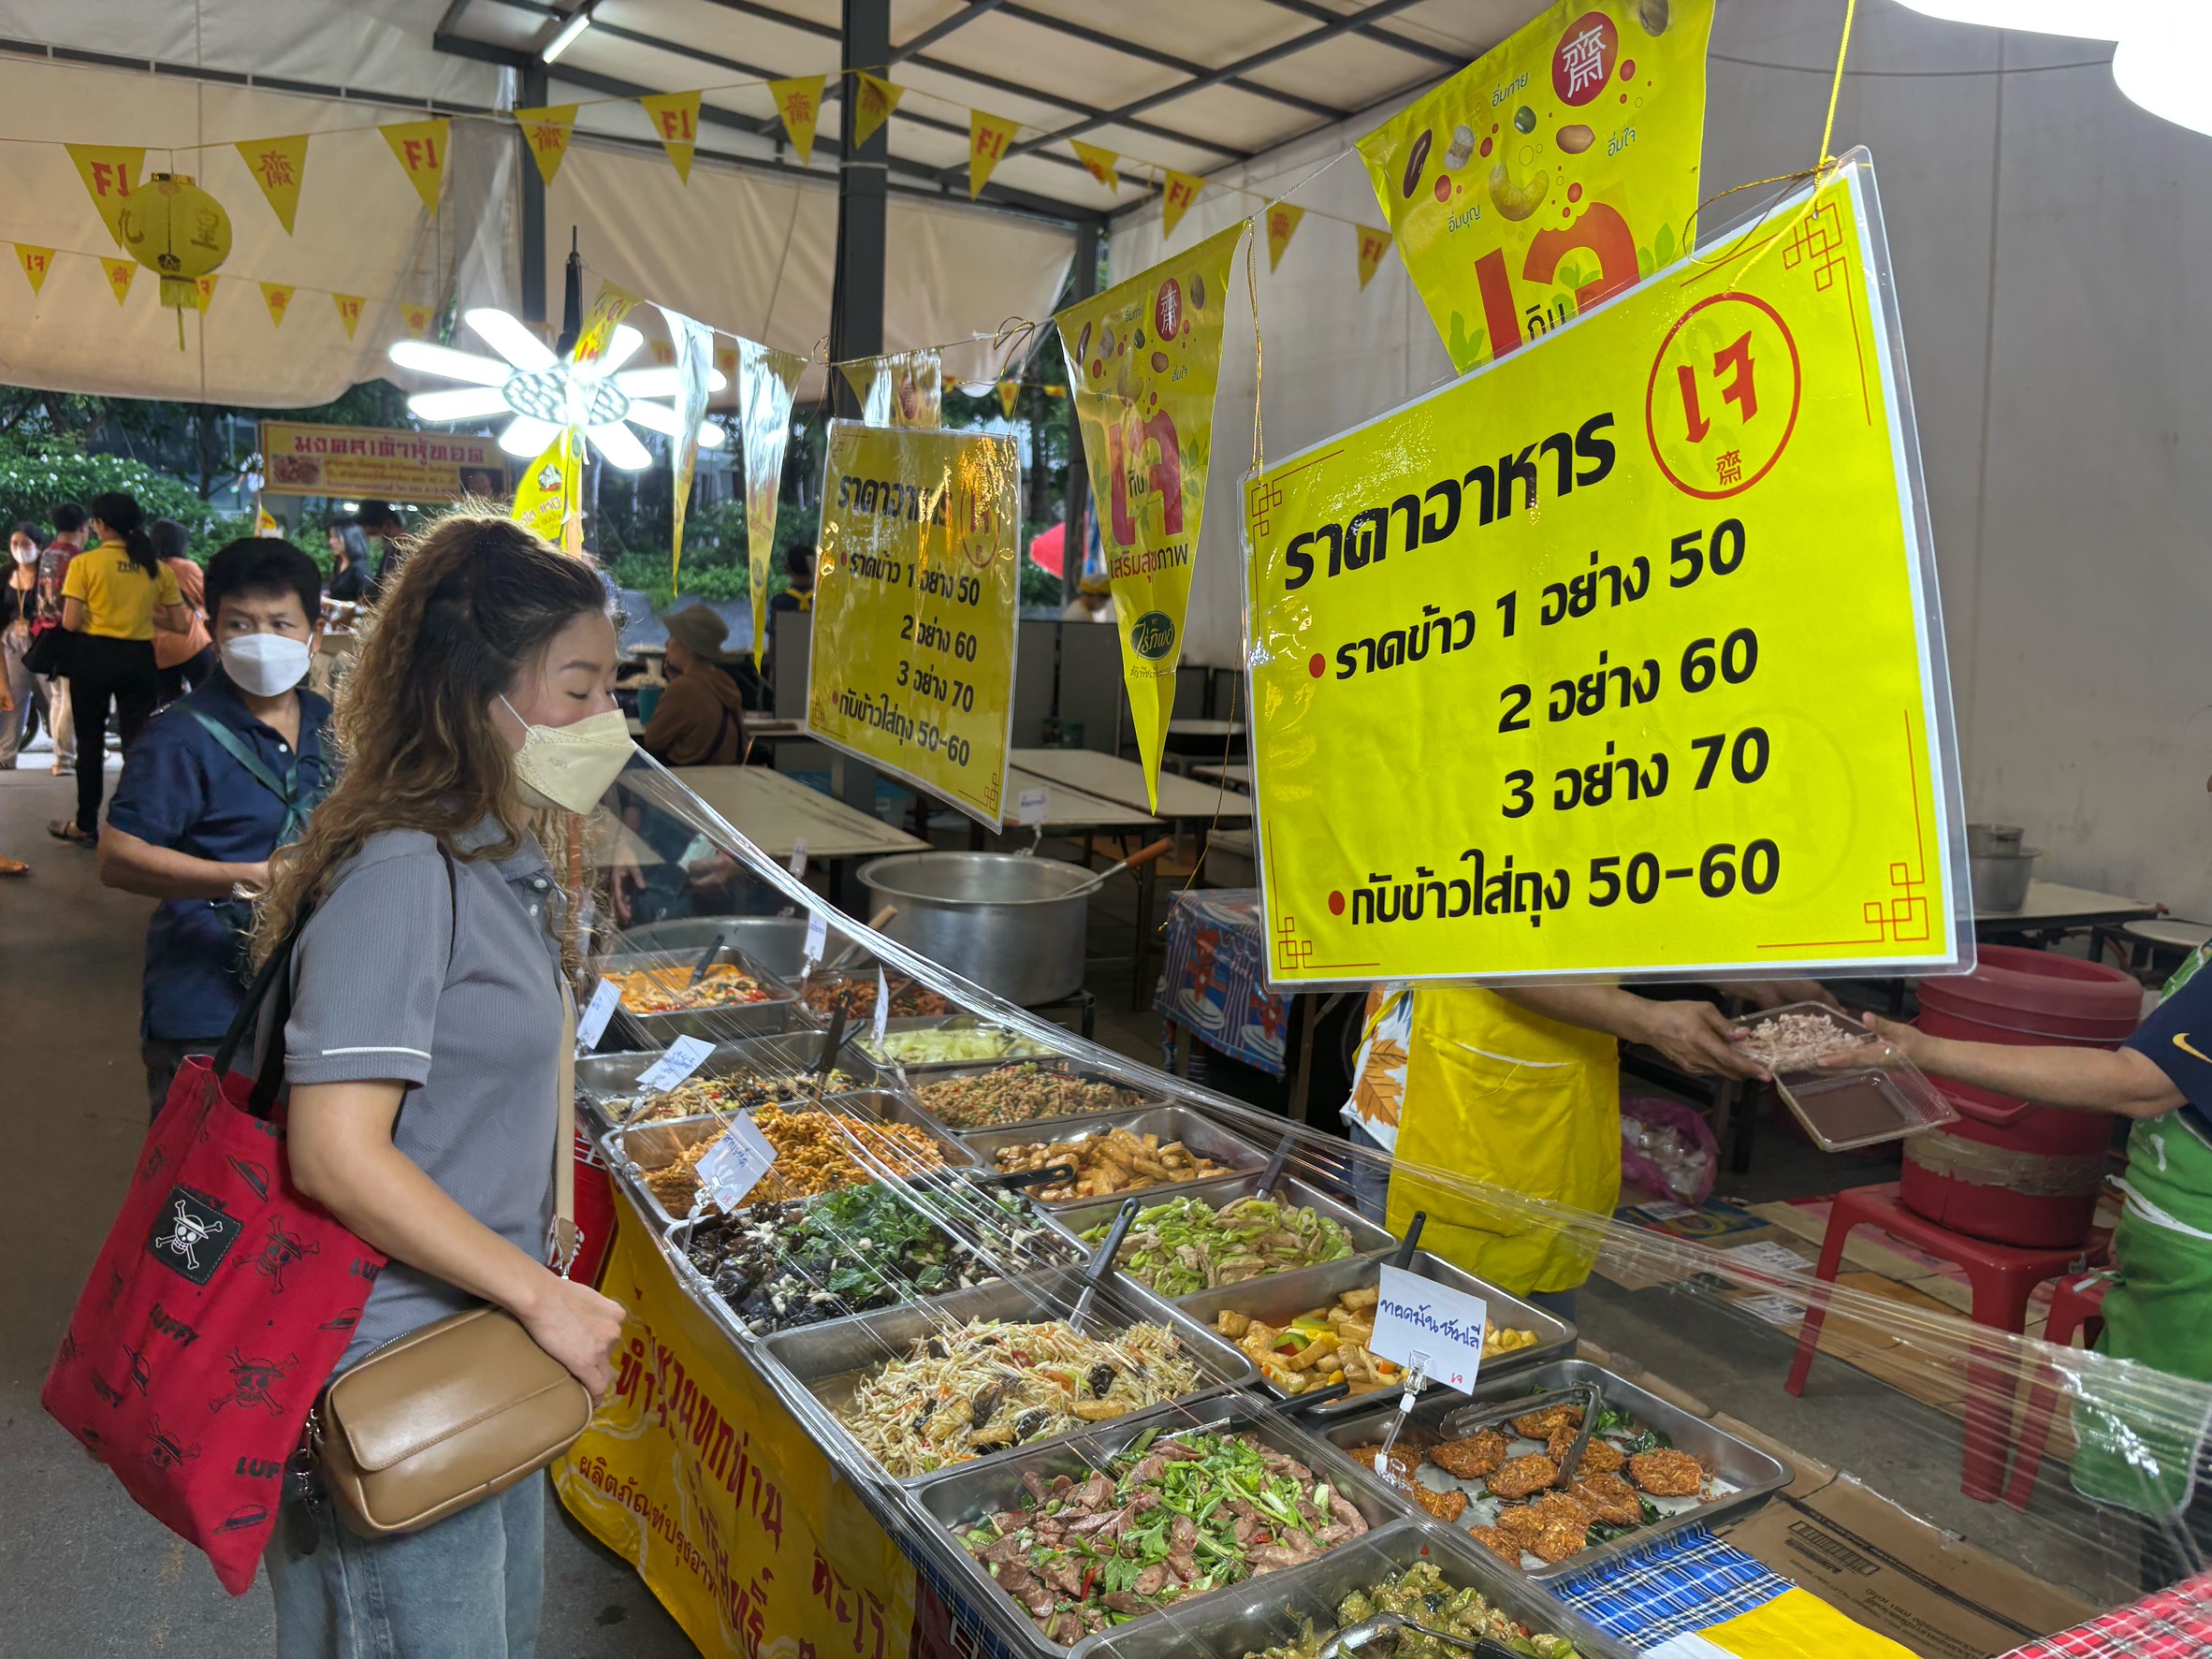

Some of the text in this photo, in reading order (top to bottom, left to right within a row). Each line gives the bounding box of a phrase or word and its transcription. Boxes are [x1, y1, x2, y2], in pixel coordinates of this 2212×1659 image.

[1492, 72, 1529, 107] อิ่มกาย
[1608, 128, 1636, 157] อิ่มใจ
[1448, 204, 1481, 233] อิ่มบุญ
[1128, 470, 1145, 498] กิน
[1285, 412, 1616, 590] ราคาอาหาร
[907, 563, 915, 588] 1
[920, 562, 953, 599] อย่าง
[957, 575, 981, 606] 50
[1110, 543, 1188, 583] เสริมสุขภาพ
[1336, 518, 1746, 680] ราดข้าว 1 อย่าง 50
[900, 614, 977, 662] 2 อย่าง 60
[896, 660, 974, 713] 3 อย่าง 70
[1498, 628, 1758, 734] 2 อย่าง 60
[839, 688, 970, 767] กับข้าวใส่ถุง 50-60
[1502, 727, 1769, 819] 3 อย่าง 70
[1352, 838, 1780, 928] กับข้าวใส่ถุง 50-60
[1380, 1299, 1481, 1349] ทอดมันหัวปลี
[1450, 1372, 1463, 1384] เจ
